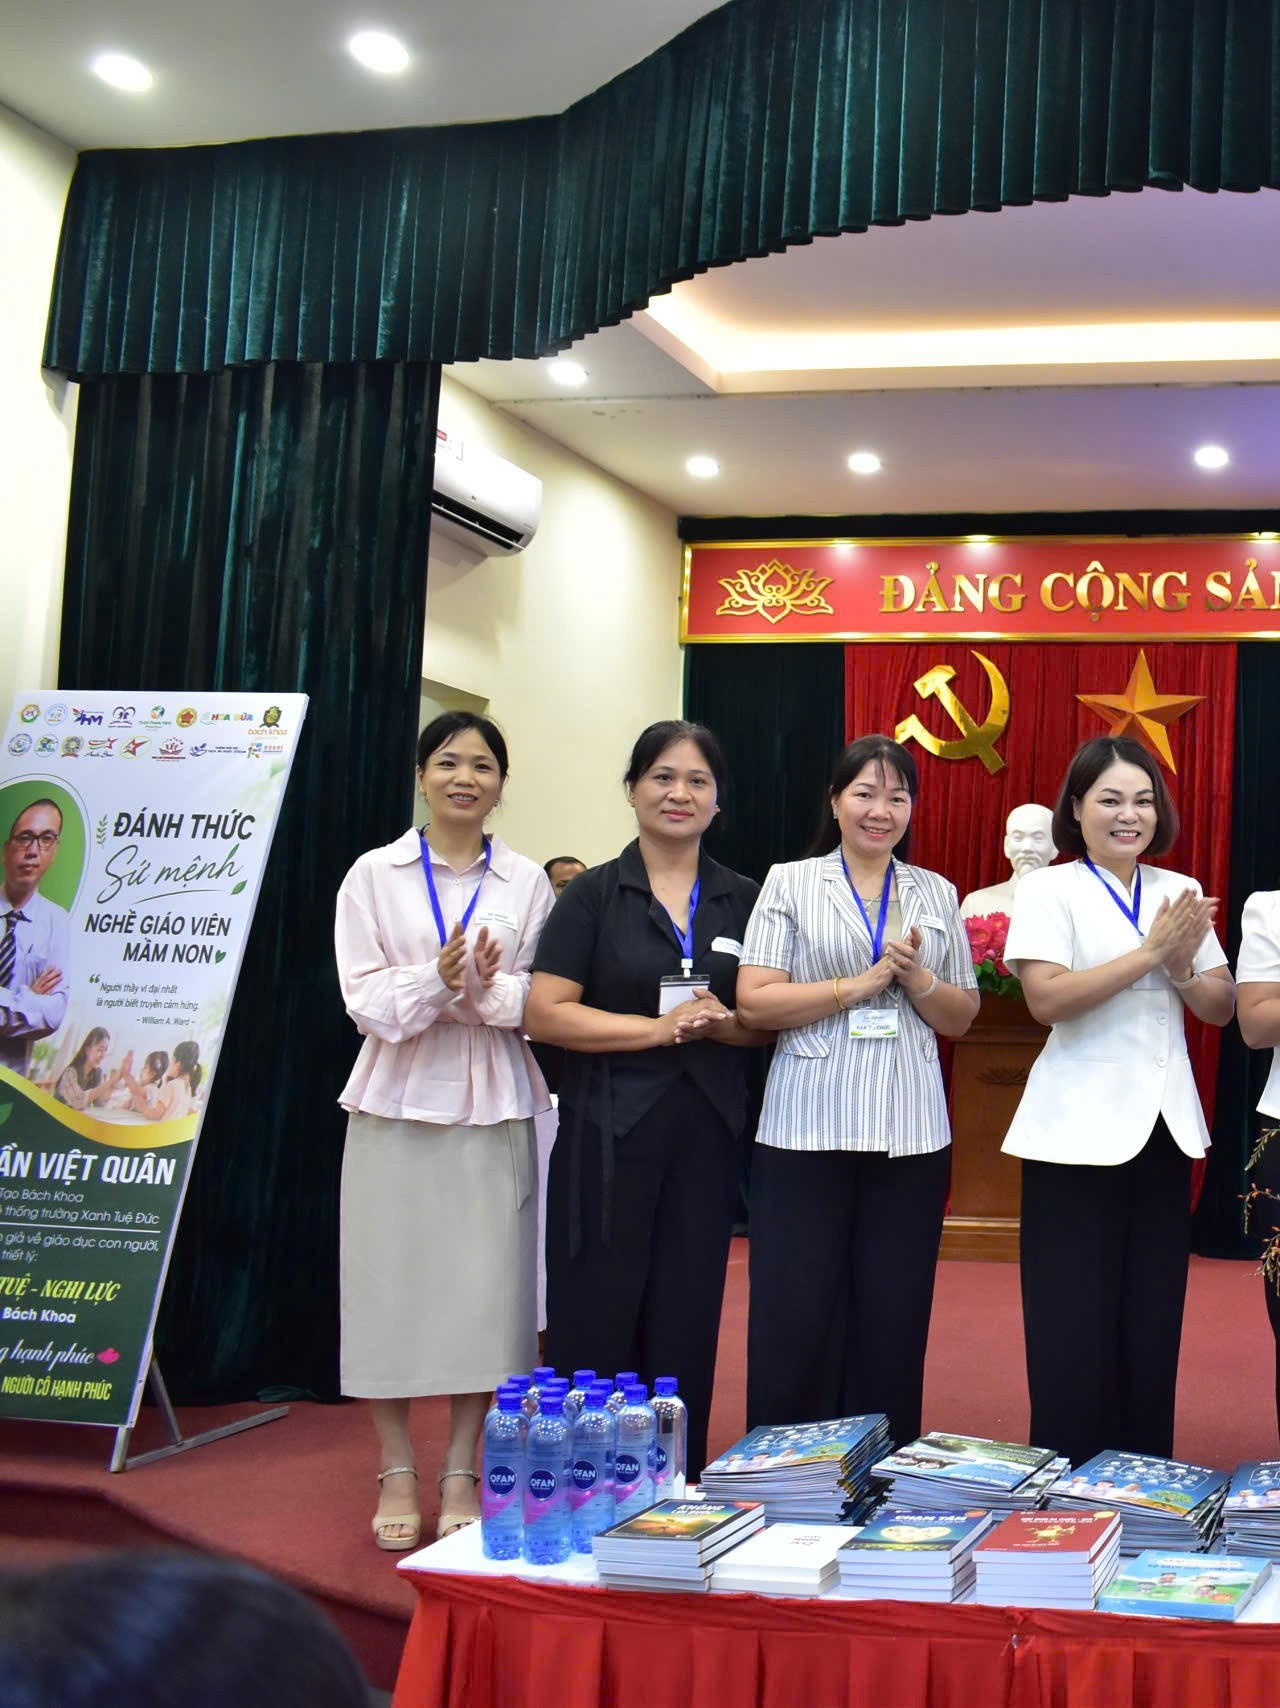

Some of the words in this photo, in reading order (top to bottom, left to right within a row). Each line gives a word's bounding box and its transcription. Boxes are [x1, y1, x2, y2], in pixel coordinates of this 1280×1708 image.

[879, 560, 1025, 613] ĐẢNG
[1040, 560, 1191, 622] CỘNG
[113, 806, 184, 838] ĐÁNH
[191, 809, 256, 840] THỨC
[96, 844, 152, 904] Sứ
[154, 843, 244, 888] mệnh
[85, 908, 137, 934] NGHỀ
[139, 912, 185, 936] GIÁO
[191, 913, 231, 936] VIÊN
[122, 937, 169, 963] MẦM
[171, 943, 214, 964] NON
[142, 1017, 165, 1025] William
[173, 1018, 190, 1026] Ward
[0, 1142, 33, 1178] ẦN
[38, 1148, 98, 1186] VIỆT
[101, 1152, 177, 1186] QUÂN
[22, 1188, 51, 1201] Bách
[54, 1190, 84, 1203] Khoa
[5, 1204, 39, 1219] thống
[41, 1208, 79, 1223] trường
[80, 1209, 111, 1222] Xanh
[114, 1211, 133, 1225] Tuệ
[134, 1212, 160, 1225] Đức
[5, 1232, 25, 1245] giả
[27, 1231, 42, 1244] về
[44, 1233, 70, 1248] giáo
[72, 1235, 95, 1249] dục
[98, 1238, 122, 1250] con
[0, 1272, 31, 1301] TUỆ
[40, 1279, 85, 1305] NGHỊ
[84, 1280, 121, 1306] LỰC
[3, 1306, 37, 1320] Bách
[40, 1309, 77, 1324] Khoa
[10, 1339, 53, 1364] hạnh
[48, 1342, 96, 1371] phúc
[1, 1374, 35, 1395] NGƯỜI
[50, 1380, 82, 1400] HẠNH
[82, 1379, 112, 1401] PHÚC
